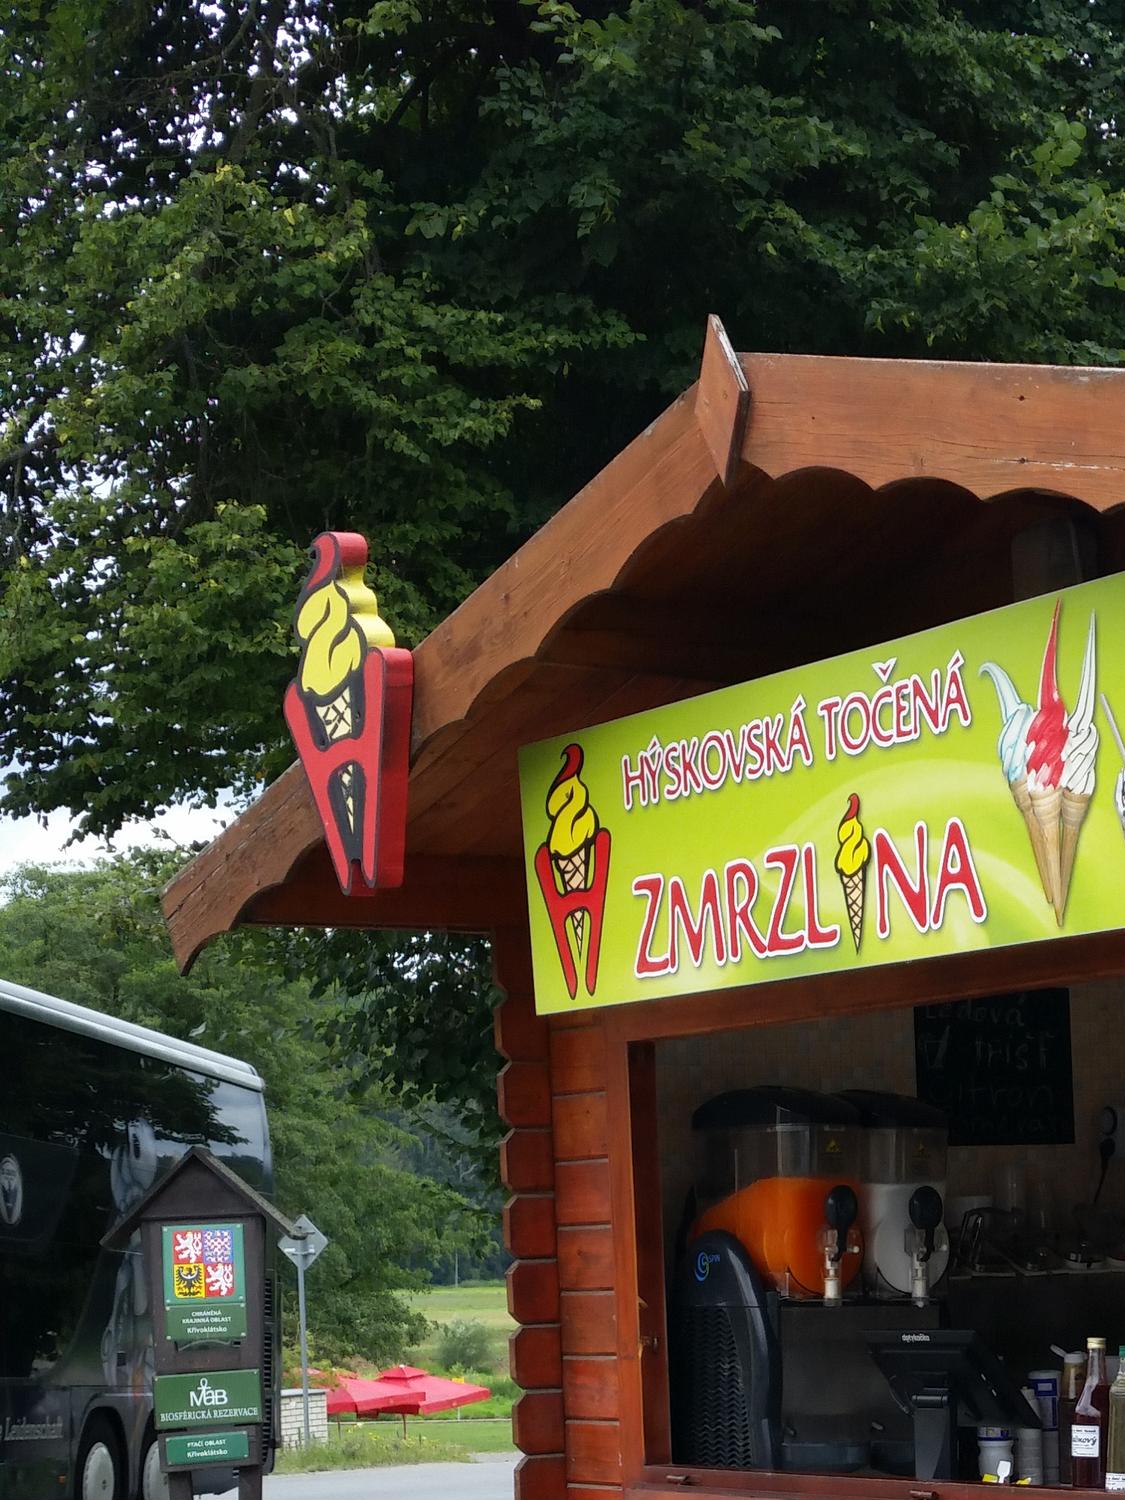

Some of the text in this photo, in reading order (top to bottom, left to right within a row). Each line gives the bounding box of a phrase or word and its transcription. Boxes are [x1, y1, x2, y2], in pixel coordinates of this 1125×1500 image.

[620, 649, 972, 811] HÝSKOVSKÁ TOČENÁ
[160, 1407, 258, 1422] BIOSFÉRICKÁ REZERVACE
[187, 1449, 228, 1458] Křivoklátsko
